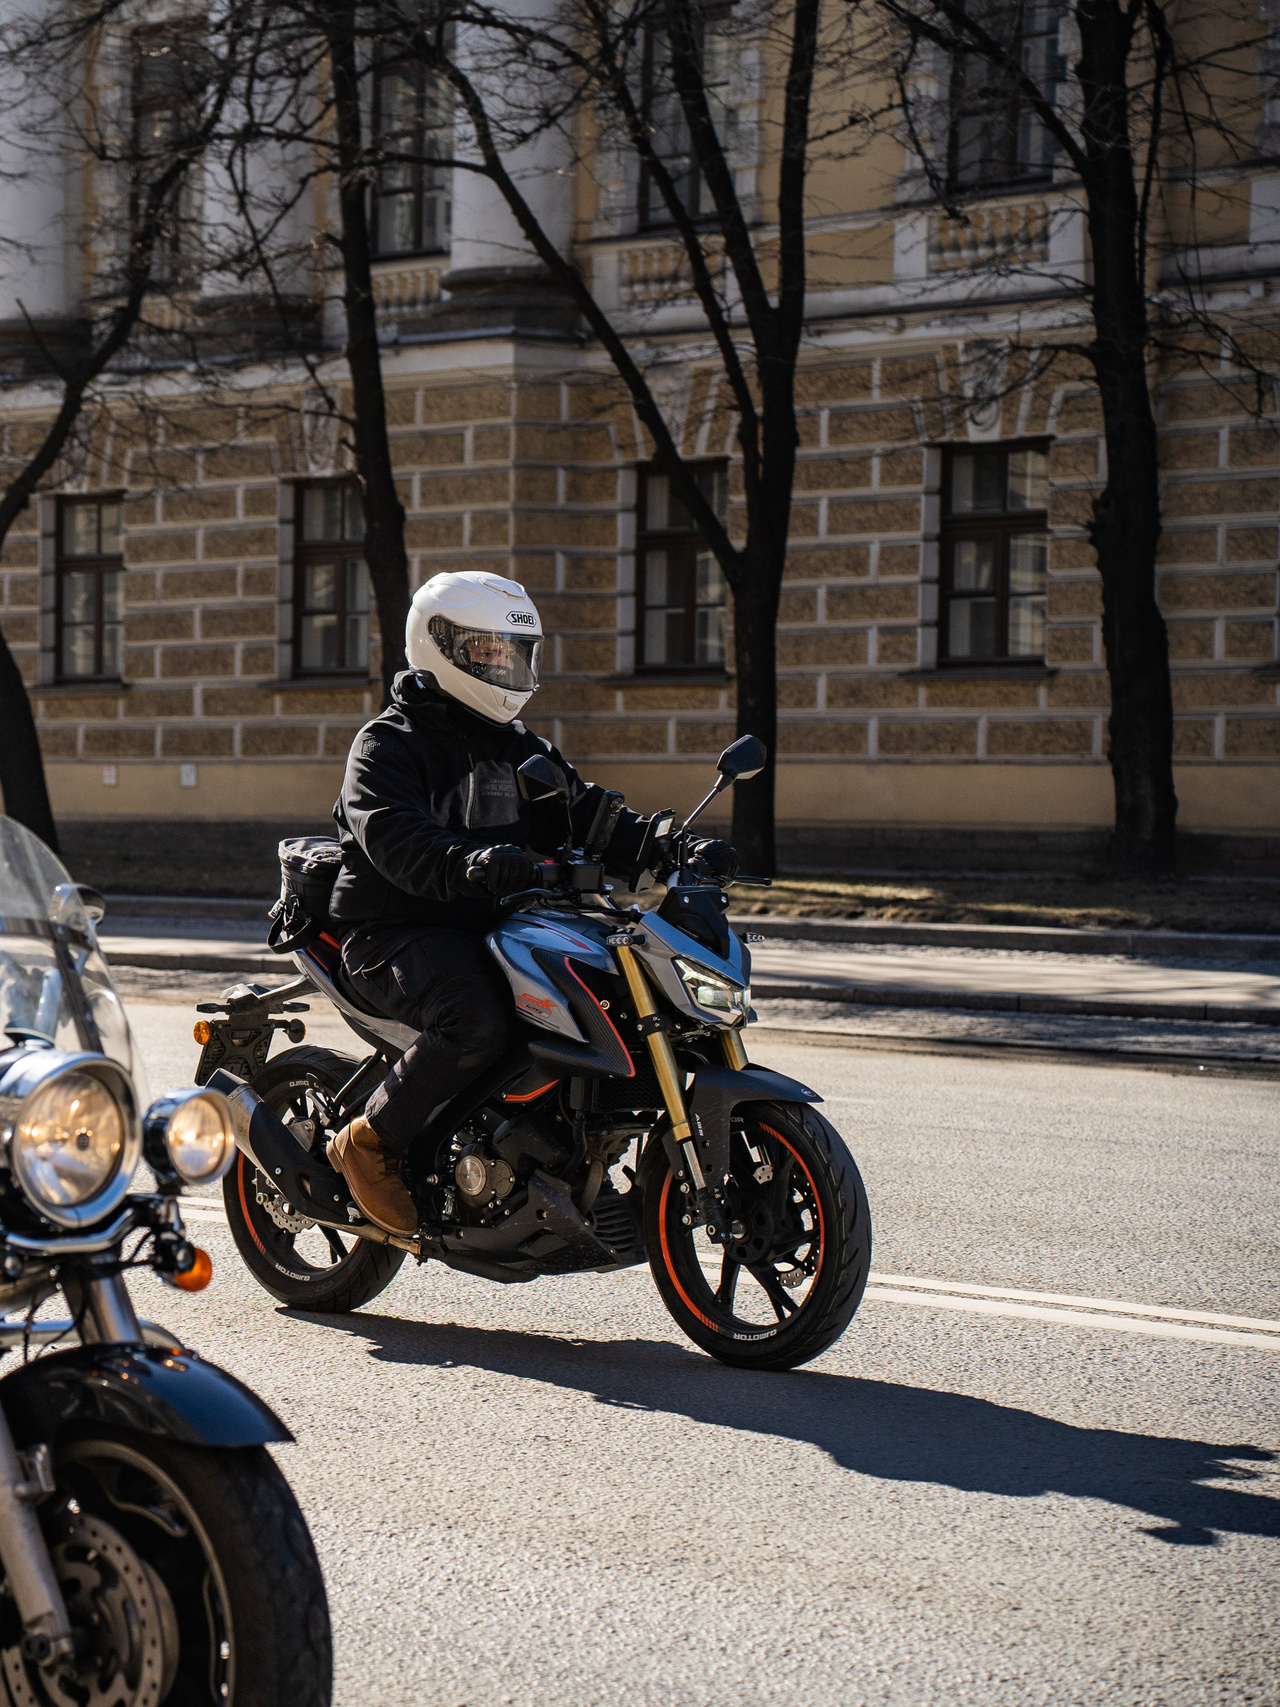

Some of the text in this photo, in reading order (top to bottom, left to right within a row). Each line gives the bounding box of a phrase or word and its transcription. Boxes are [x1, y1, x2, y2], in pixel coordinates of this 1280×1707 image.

[511, 613, 535, 625] SHOEI
[516, 992, 558, 1015] SRK
[275, 1262, 310, 1281] QJMOTOR
[733, 1328, 777, 1341] QJMOTOR
